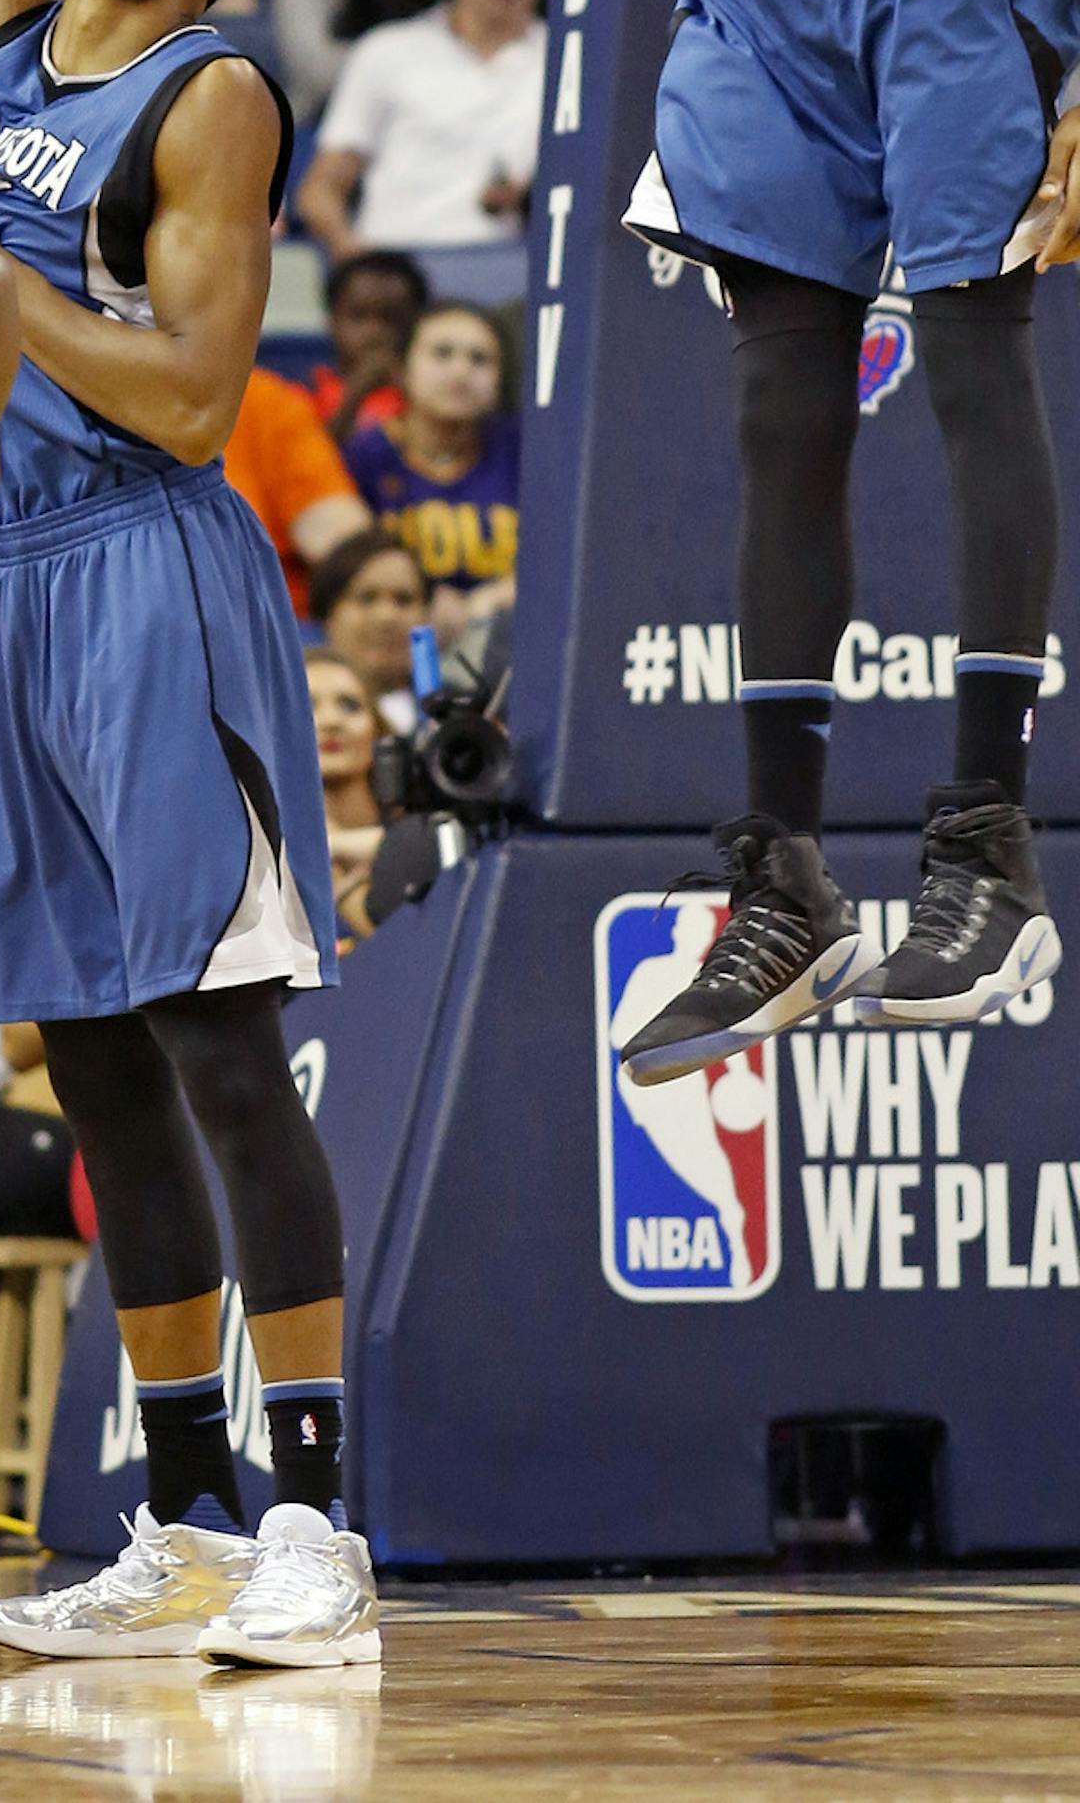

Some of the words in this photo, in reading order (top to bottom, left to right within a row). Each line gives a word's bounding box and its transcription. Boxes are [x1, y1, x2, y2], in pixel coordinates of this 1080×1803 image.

[536, 184, 573, 408] TV
[790, 1031, 973, 1158] WHY
[626, 1215, 722, 1272] NBA
[800, 1163, 923, 1290] WE
